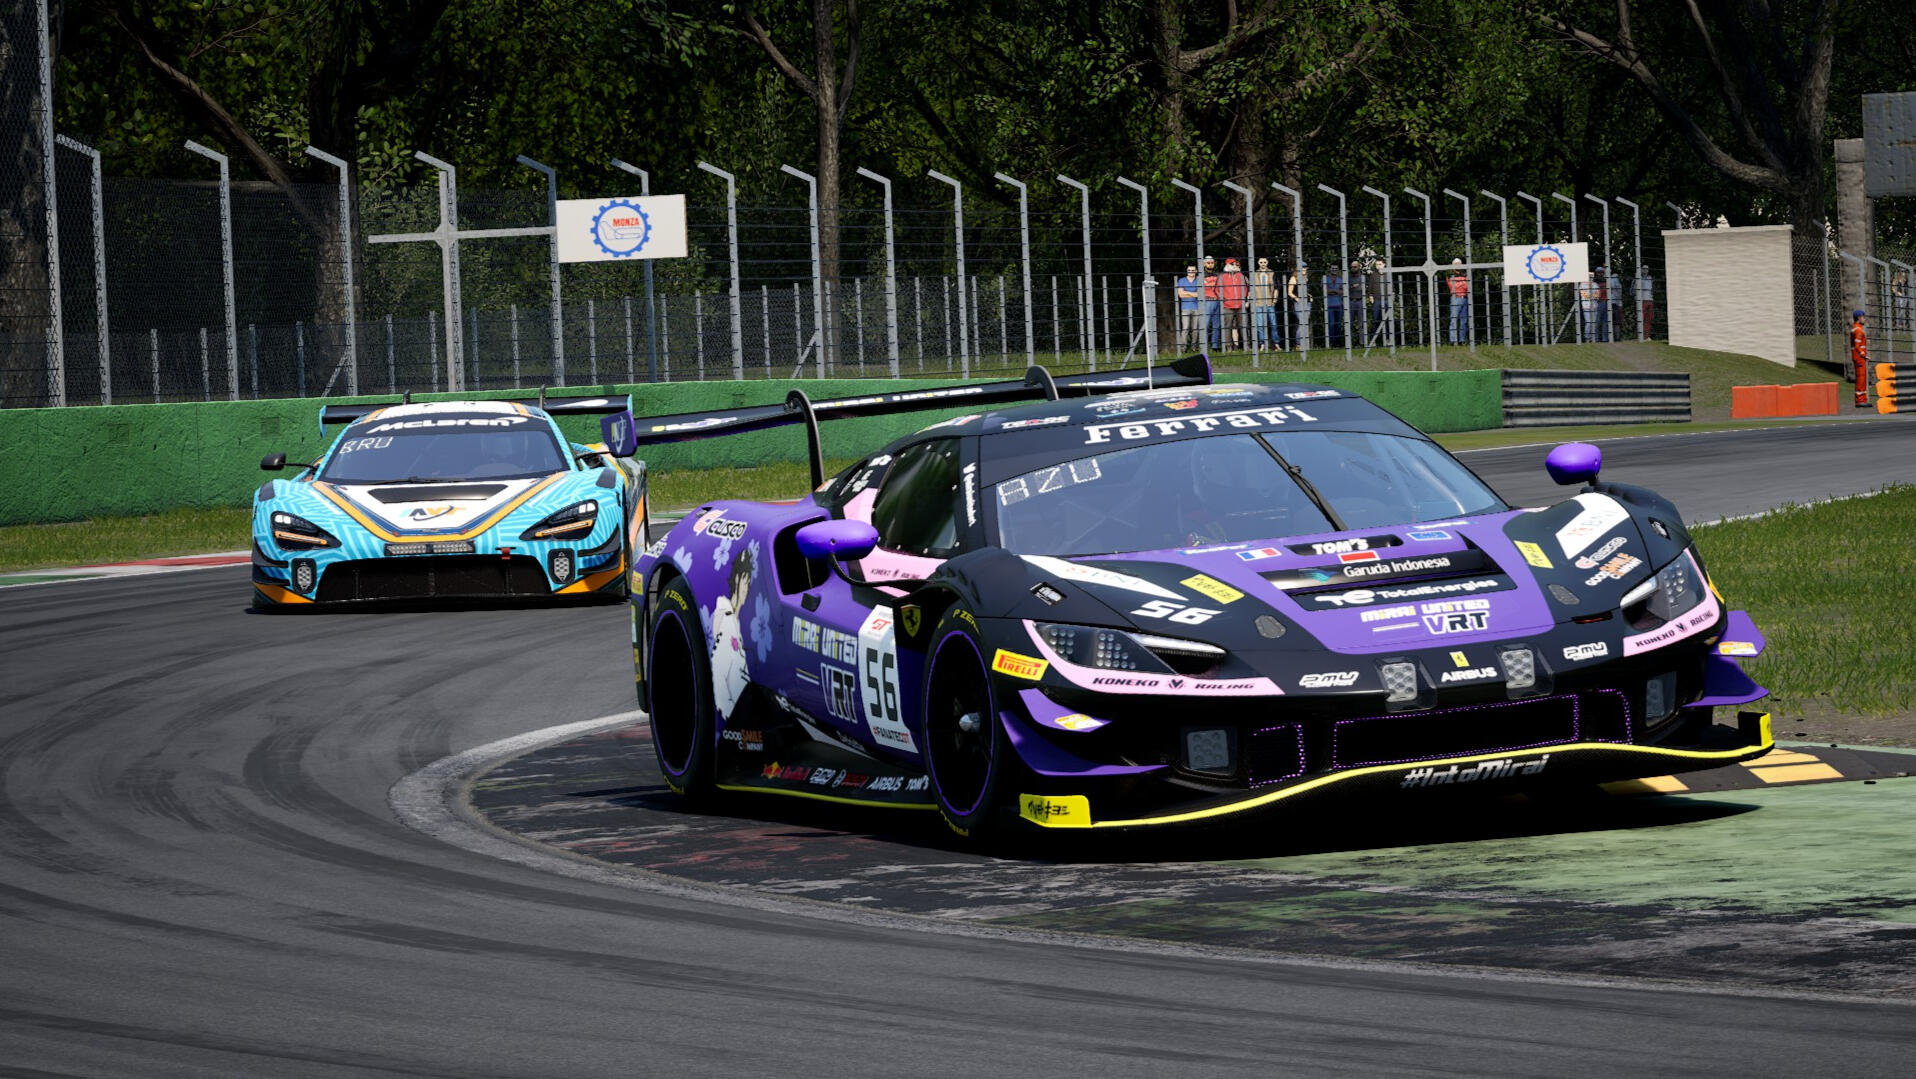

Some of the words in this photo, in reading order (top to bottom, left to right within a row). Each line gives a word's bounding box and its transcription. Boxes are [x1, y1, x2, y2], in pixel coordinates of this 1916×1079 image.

[613, 217, 640, 227] MONZA
[366, 416, 528, 434] McLaren
[1084, 406, 1318, 444] Ferrari
[339, 436, 394, 454] BRU
[998, 458, 1102, 506] AZU
[706, 518, 747, 540] CUSCO
[1312, 539, 1369, 555] TOM'S
[1344, 563, 1391, 578] Garuda
[1391, 556, 1451, 573] Indonesia
[1377, 579, 1499, 600] TotalEnergies
[1130, 600, 1225, 625] 56
[1422, 610, 1491, 635] VRT
[1635, 630, 1675, 647] KONEKO
[998, 654, 1042, 676] PIRELLI
[1441, 666, 1498, 683] AIRBUS
[820, 662, 858, 724] VRT
[866, 647, 898, 722] 56
[1092, 676, 1160, 687] KONEKO
[1194, 681, 1256, 690] RACING
[1400, 754, 1550, 788] #IntoMirai
